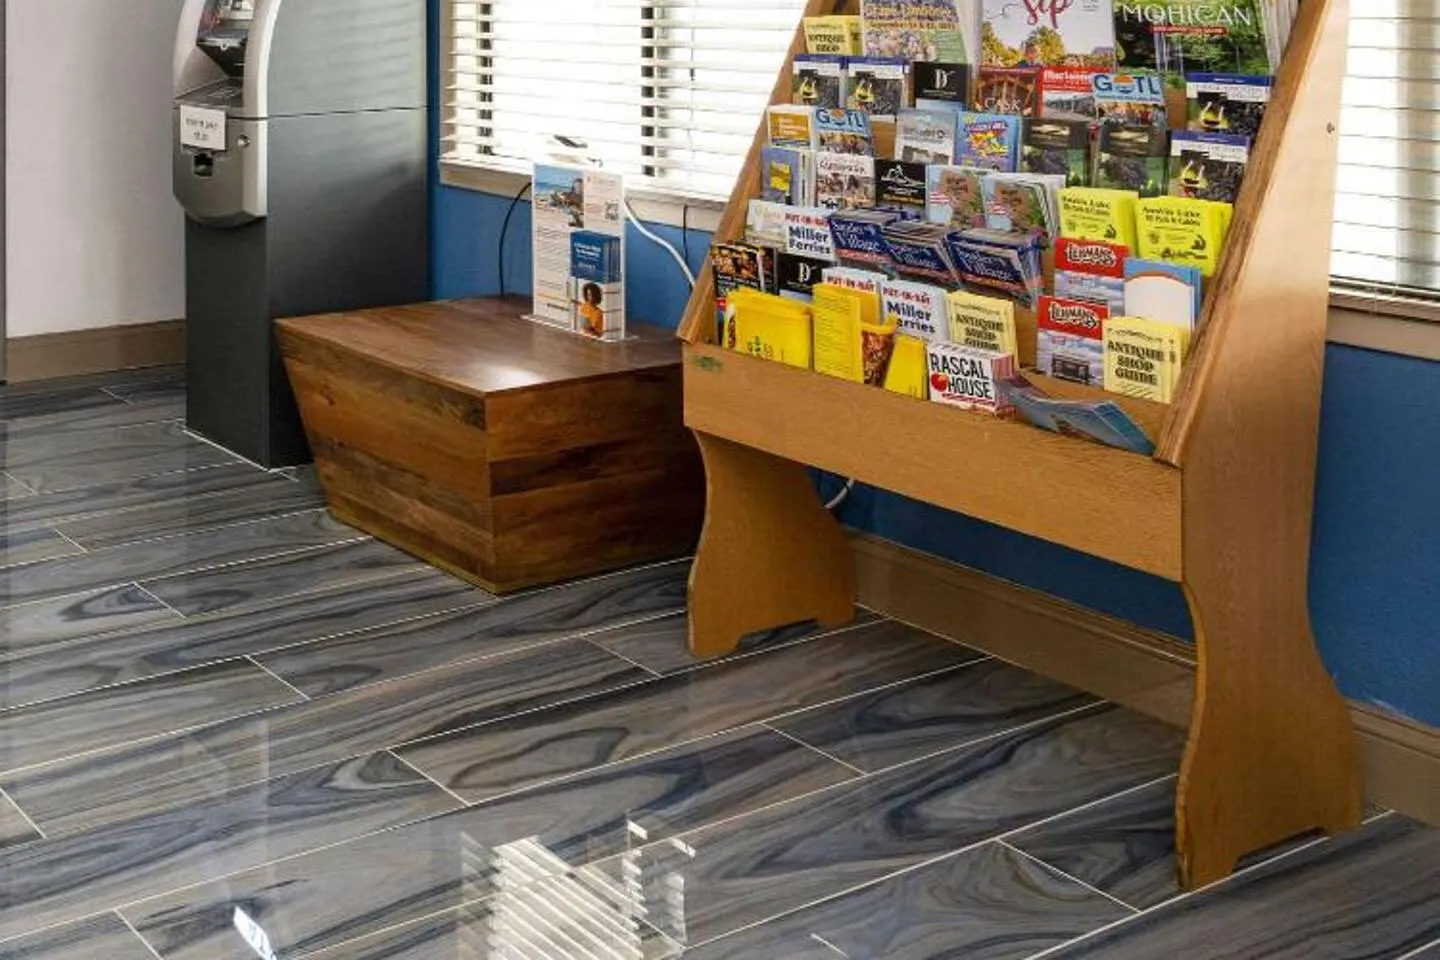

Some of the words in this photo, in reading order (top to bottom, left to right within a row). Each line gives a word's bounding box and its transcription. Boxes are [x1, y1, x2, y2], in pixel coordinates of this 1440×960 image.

[1122, 4, 1252, 25] MOHICAN
[789, 226, 829, 243] Miller
[789, 240, 831, 255] Ferries
[887, 301, 932, 322] Miller
[896, 318, 936, 334] erries
[956, 314, 1004, 331] ANTIQUE
[1107, 339, 1165, 362] ANTIQUE
[929, 352, 990, 380] RASCAL
[1117, 355, 1155, 372] SHOP
[1115, 369, 1158, 386] GUIDE
[948, 376, 993, 400] HOUSE
